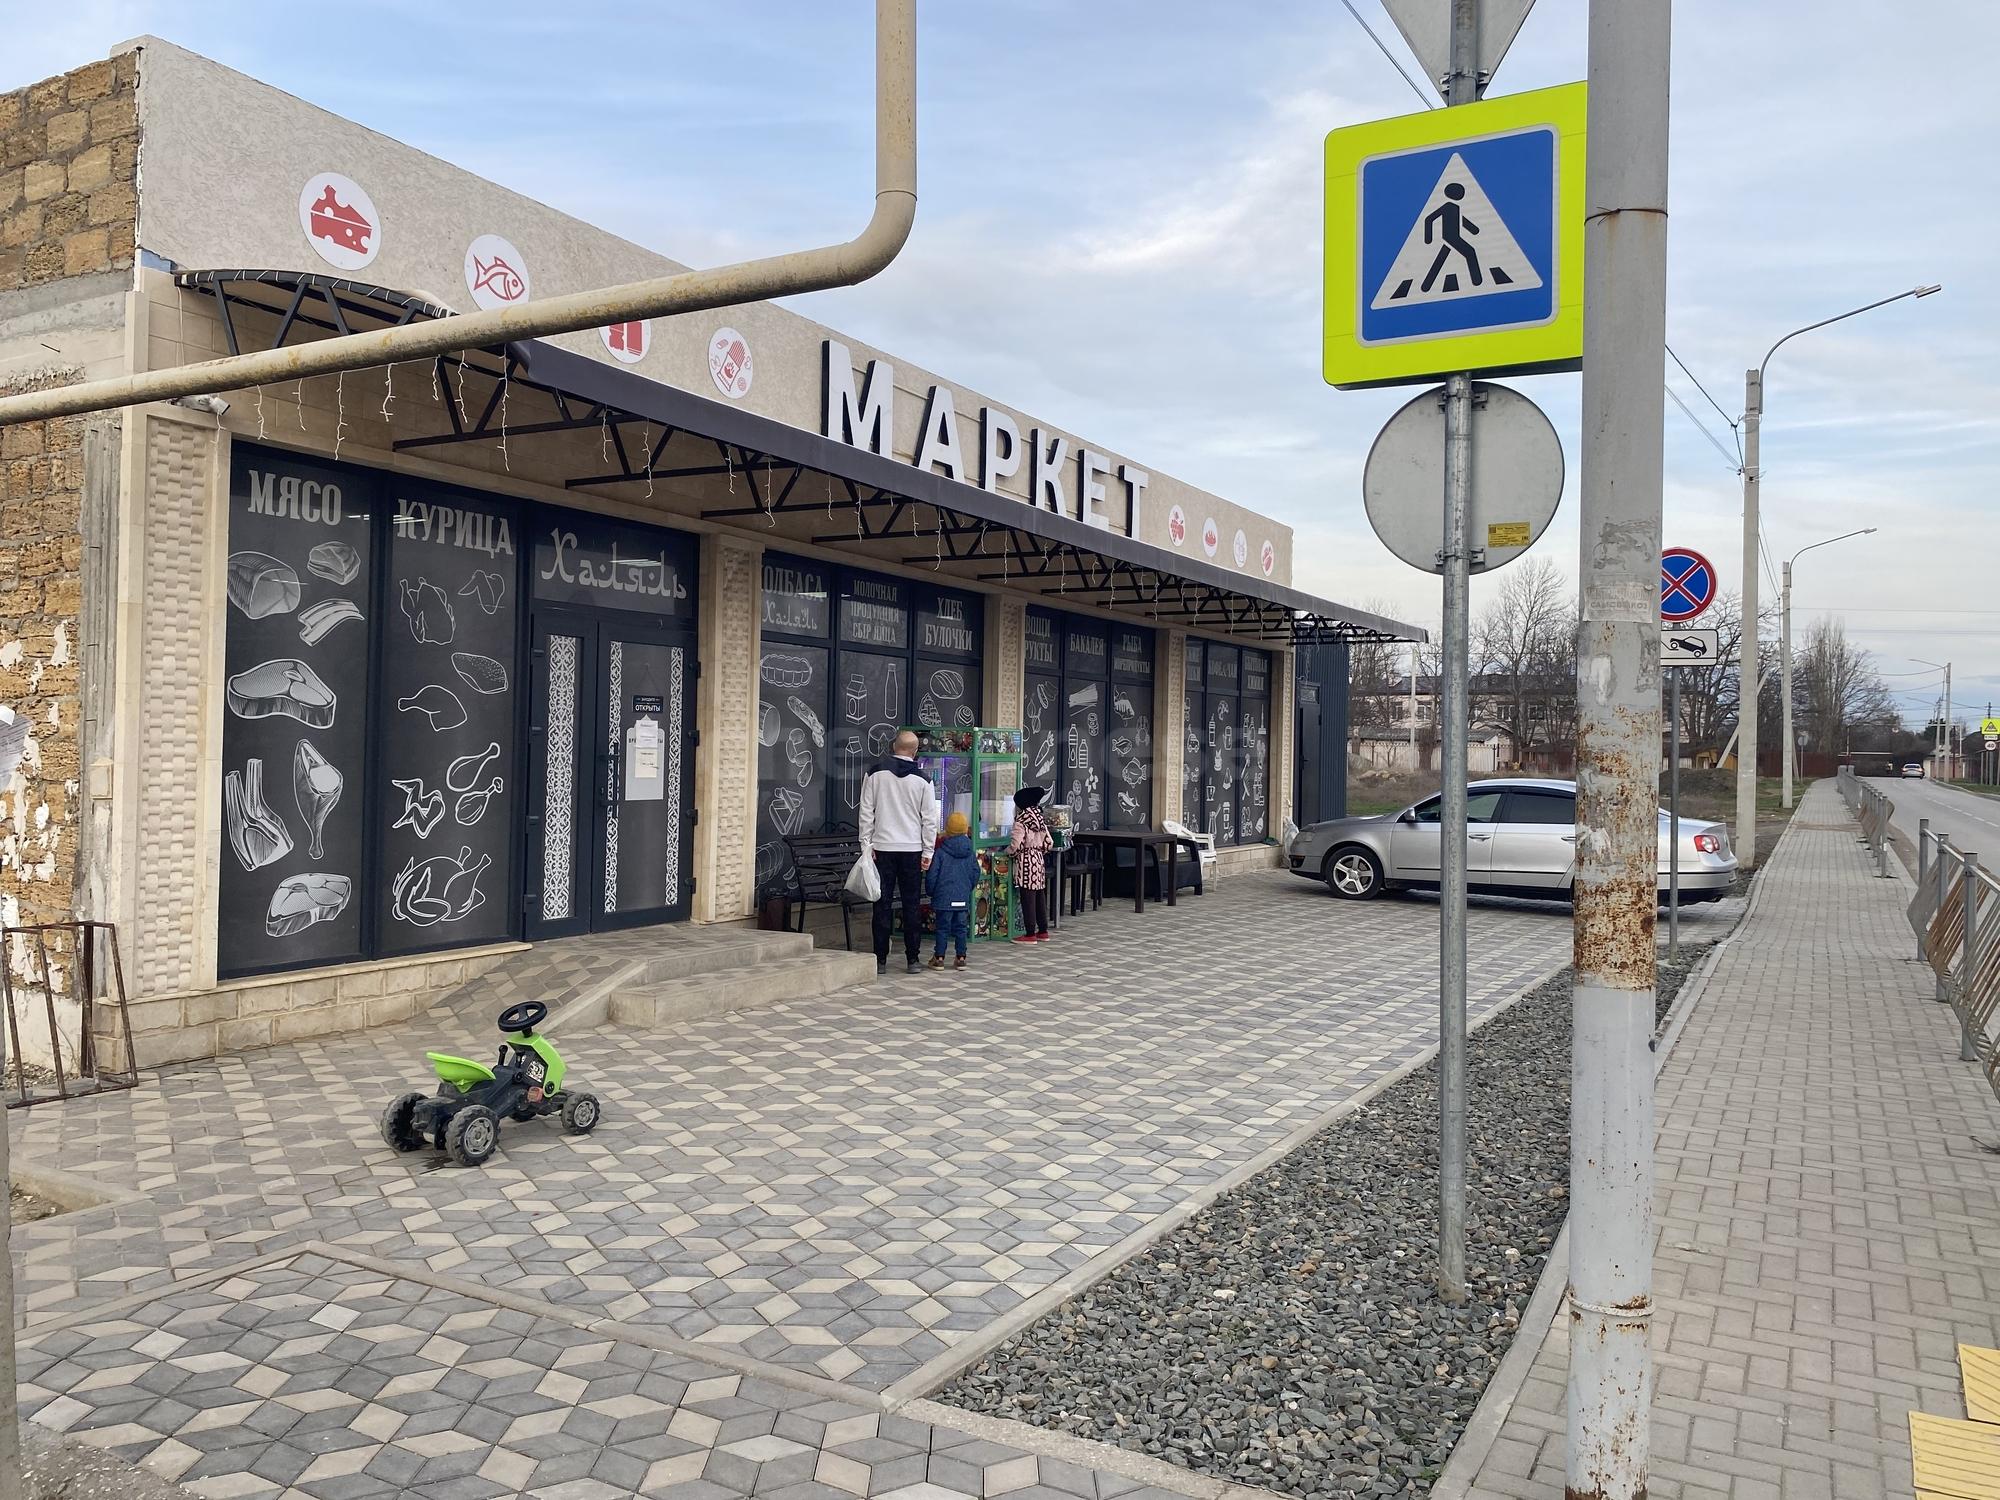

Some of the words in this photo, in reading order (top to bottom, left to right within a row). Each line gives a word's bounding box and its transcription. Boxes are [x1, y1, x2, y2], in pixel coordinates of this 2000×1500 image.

[822, 339, 1149, 541] МАРКЕТ
[247, 470, 342, 527] МЯСО
[397, 499, 513, 559] КУРИЦА
[762, 565, 824, 603] ОЛБАСА
[853, 580, 897, 602] МОЛОЧНАЯ
[850, 602, 899, 624] ПРОДУКЦИЯ
[937, 597, 963, 621] ХЛЕБ
[852, 622, 872, 639] СЫР
[925, 624, 972, 651] БУЛОЧКИ
[1024, 615, 1050, 641] ВОЩИ
[1024, 640, 1053, 663] РУКТЫ
[1070, 633, 1104, 656] БАКАЛЕЯ
[635, 704, 661, 712] ОТКРЫТЫ
